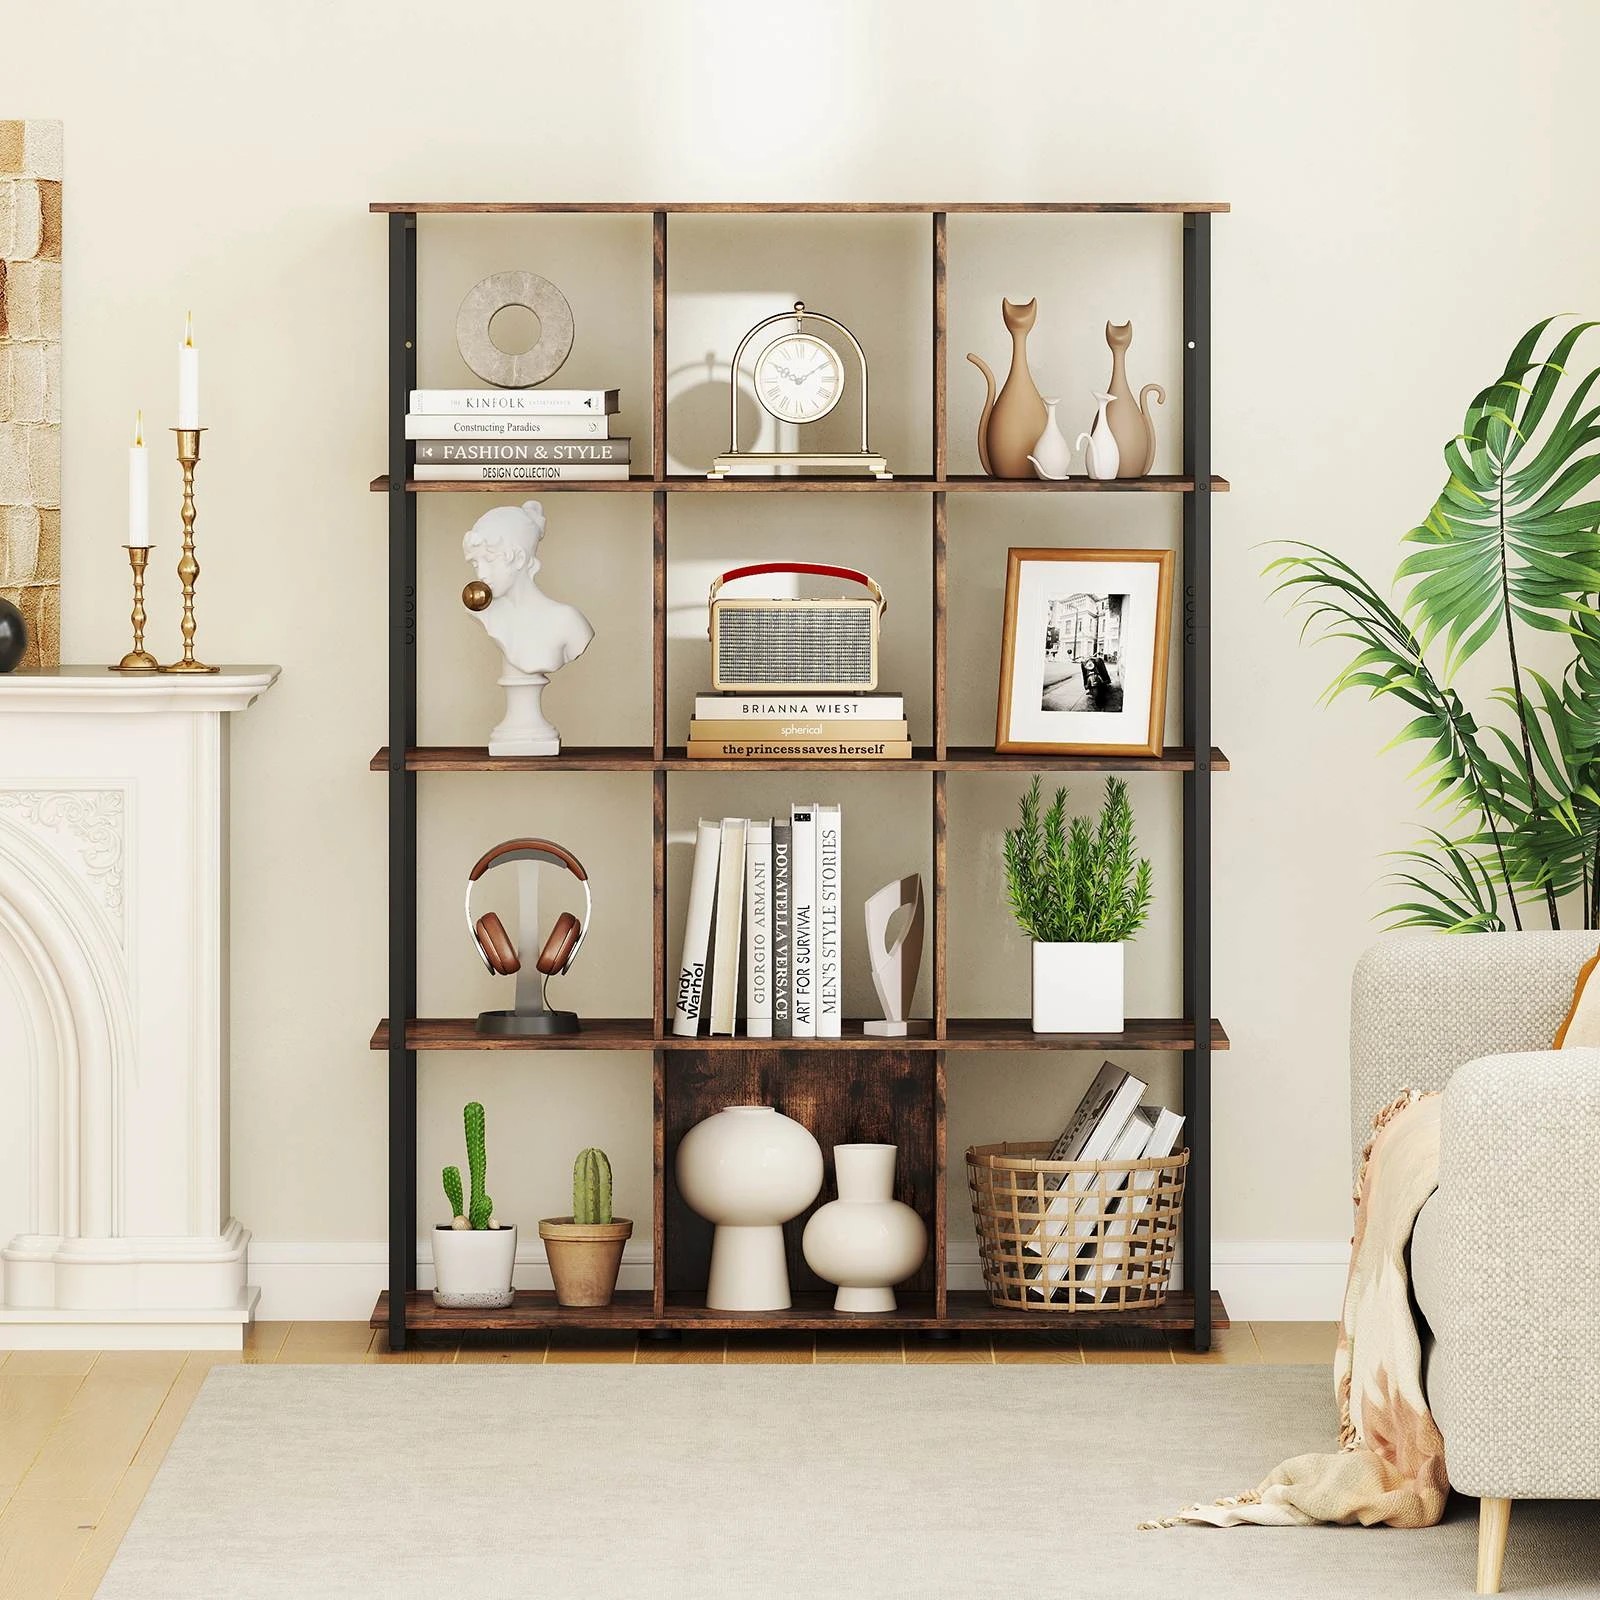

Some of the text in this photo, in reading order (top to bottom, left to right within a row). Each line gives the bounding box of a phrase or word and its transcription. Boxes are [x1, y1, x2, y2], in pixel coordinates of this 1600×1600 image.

[466, 398, 525, 408] KINFOLK
[453, 422, 505, 434] Constructing
[443, 445, 613, 460] FASHION & STYLE
[482, 467, 561, 479] DESIGN COLLECTION
[742, 704, 859, 714] BRIANNA WIEST
[780, 723, 823, 737] spherical
[722, 744, 885, 758] the princess saves herself
[821, 829, 837, 1015] MEN'S STYLE STORIES
[753, 861, 766, 1005] GIORGIO ARMANI
[775, 843, 789, 1021] DONATELLA VERSACE
[796, 904, 811, 1024] ART FOR SURVIVAL
[676, 967, 694, 1012] Andy
[686, 962, 704, 1020] Warhol
